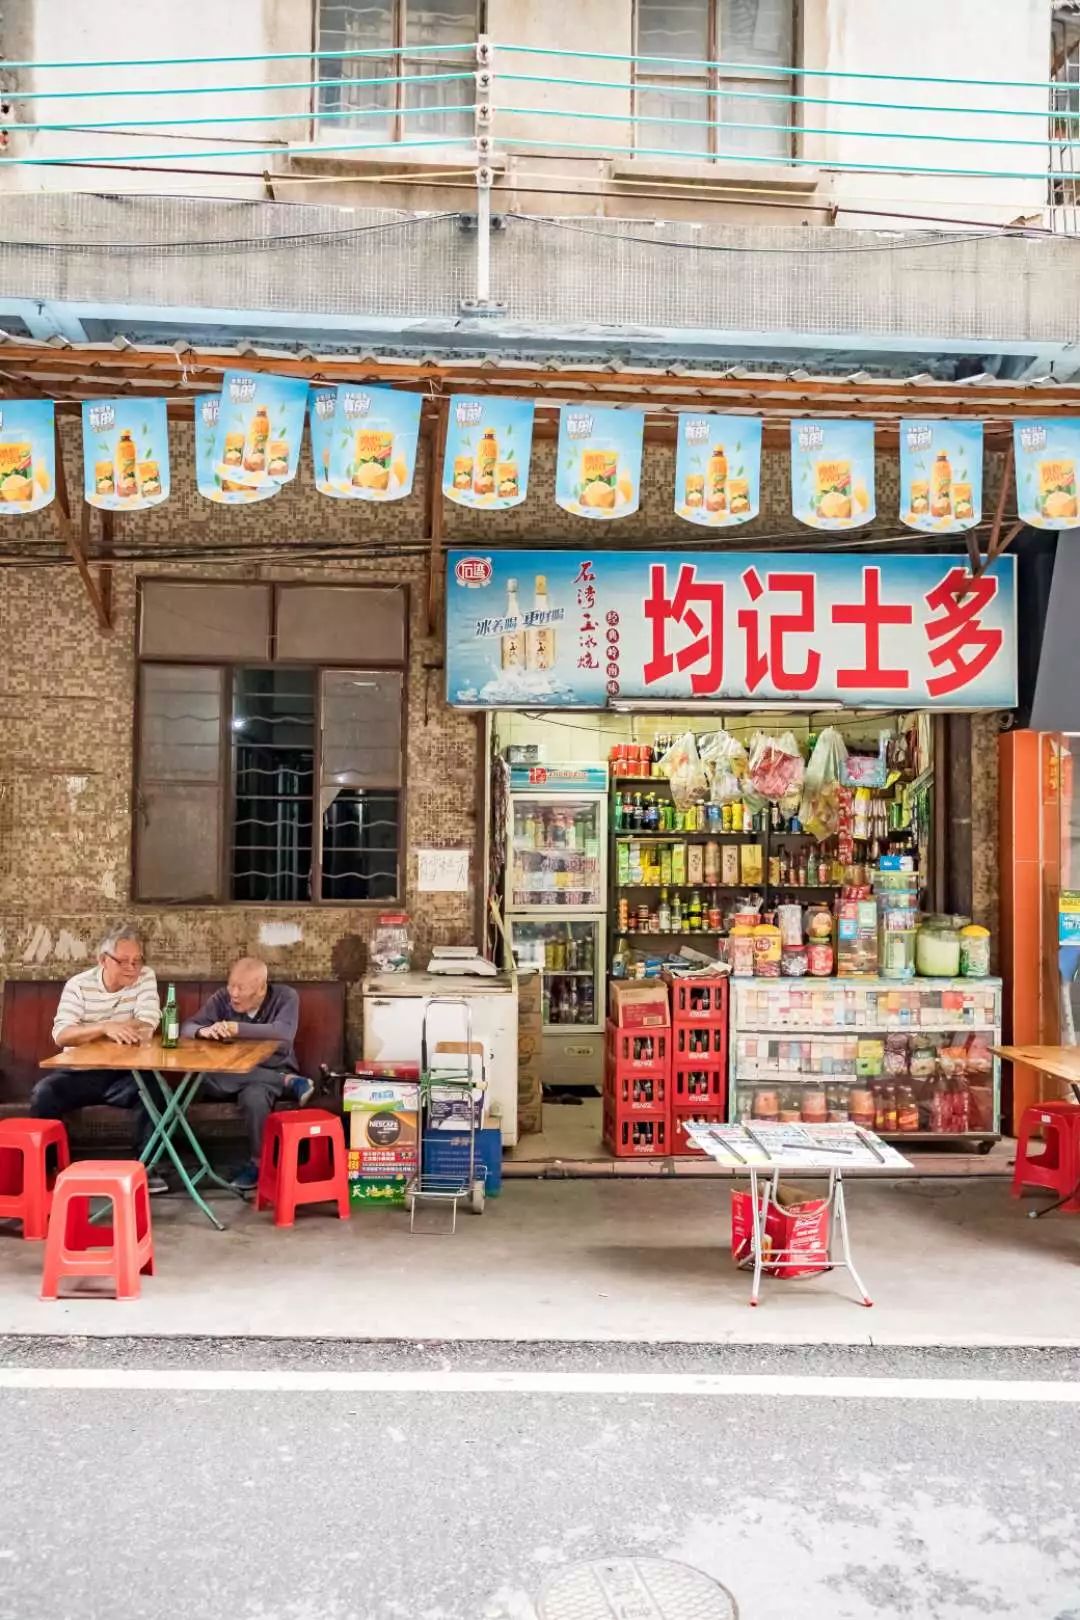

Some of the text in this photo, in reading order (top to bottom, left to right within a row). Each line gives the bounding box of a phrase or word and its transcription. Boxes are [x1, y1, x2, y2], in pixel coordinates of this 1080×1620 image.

[461, 562, 486, 580] 石湾
[573, 560, 600, 669] 石湾玉冰烧
[643, 563, 1003, 698] 均记士多
